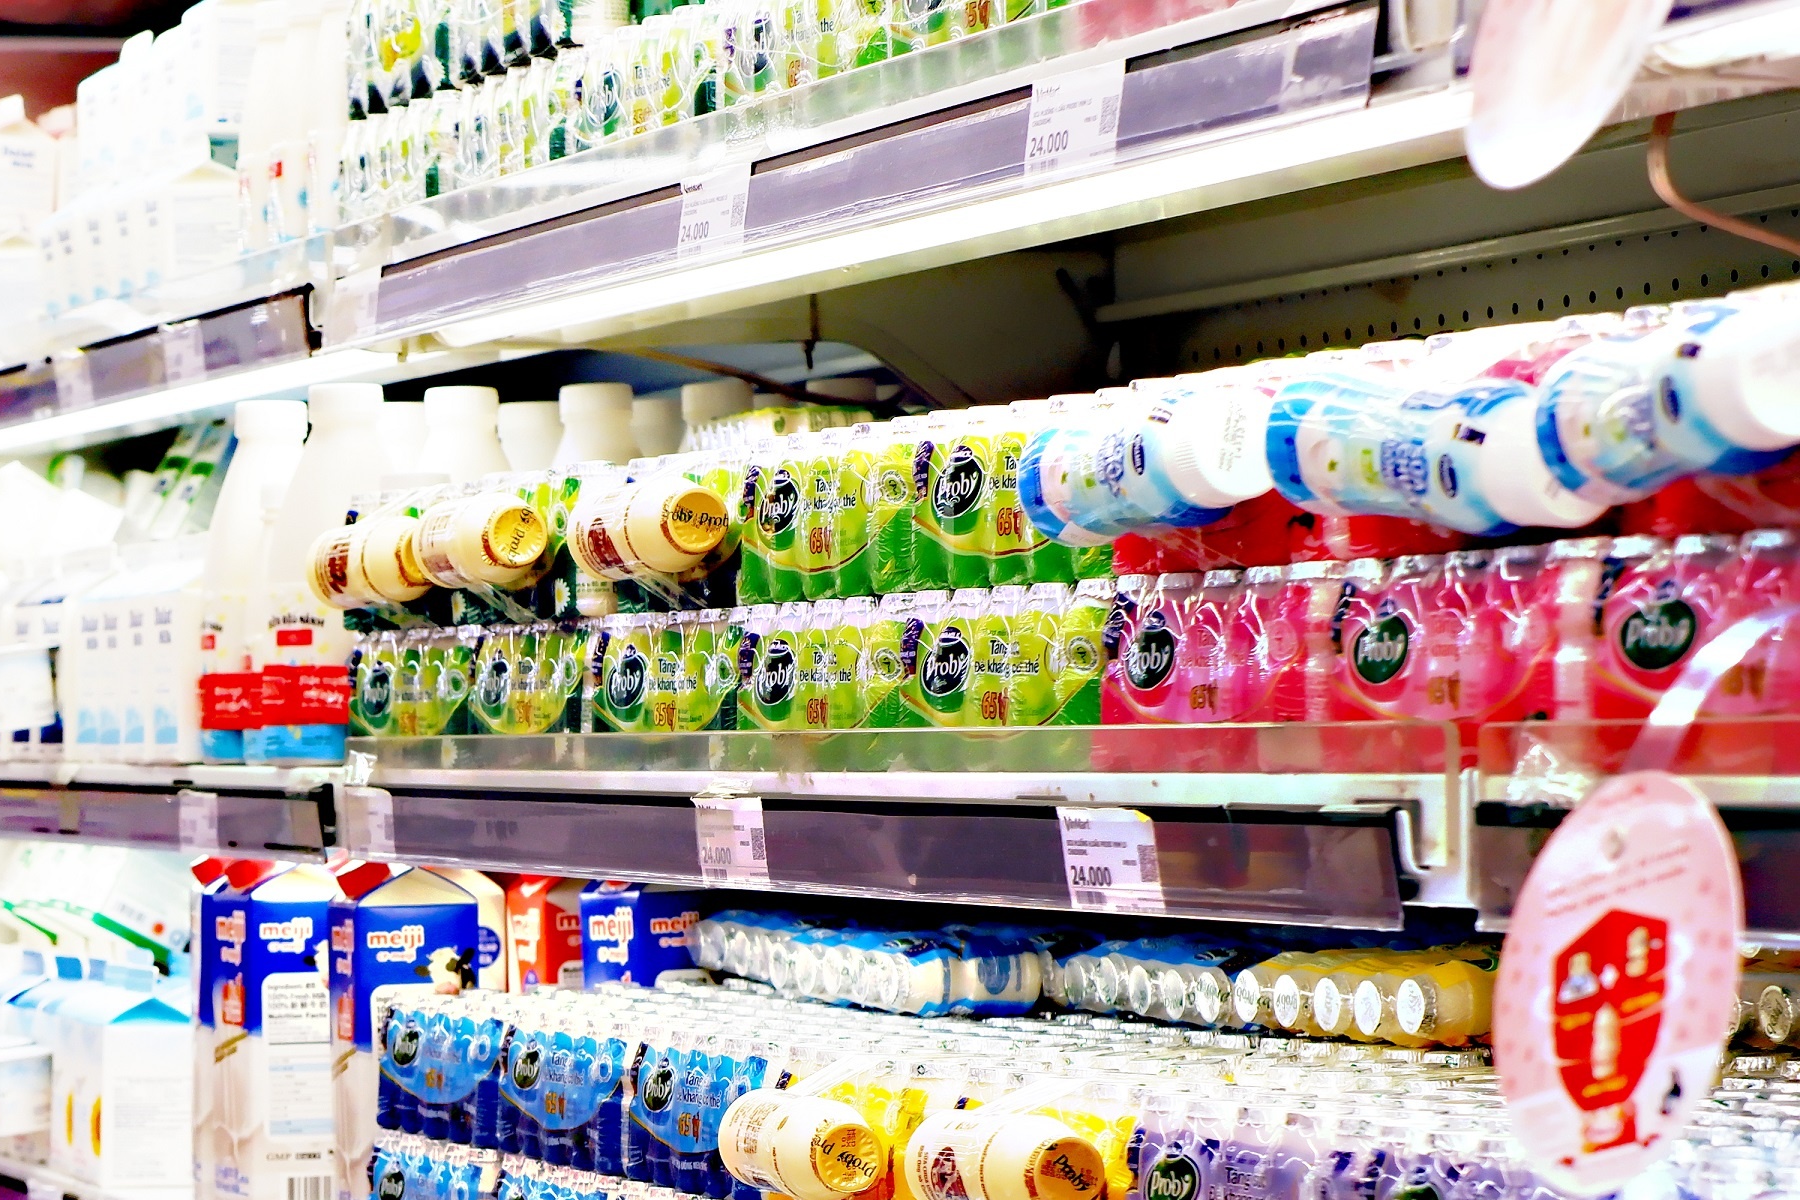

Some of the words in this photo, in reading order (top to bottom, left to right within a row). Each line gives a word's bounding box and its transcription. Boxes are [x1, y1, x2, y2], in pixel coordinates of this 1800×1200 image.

[1029, 130, 1068, 157] 24.000
[681, 221, 709, 243] 24.000
[937, 470, 980, 507] Proby
[760, 492, 796, 523] Proby
[997, 509, 1012, 536] 65
[810, 527, 823, 554] 65
[757, 655, 795, 693] Proby
[926, 654, 969, 683] Proby
[652, 702, 666, 727] 65
[807, 698, 820, 724] 65
[982, 691, 998, 719] 65
[702, 846, 731, 865] 24.000
[1070, 865, 1112, 887] 24.000
[259, 916, 314, 943] meiji
[367, 924, 426, 950] meiji
[589, 907, 634, 940] meiji
[644, 1076, 672, 1101] Proby
[545, 1092, 557, 1115] 65
[678, 1113, 692, 1137] 65
[1150, 1169, 1191, 1200] Proby
